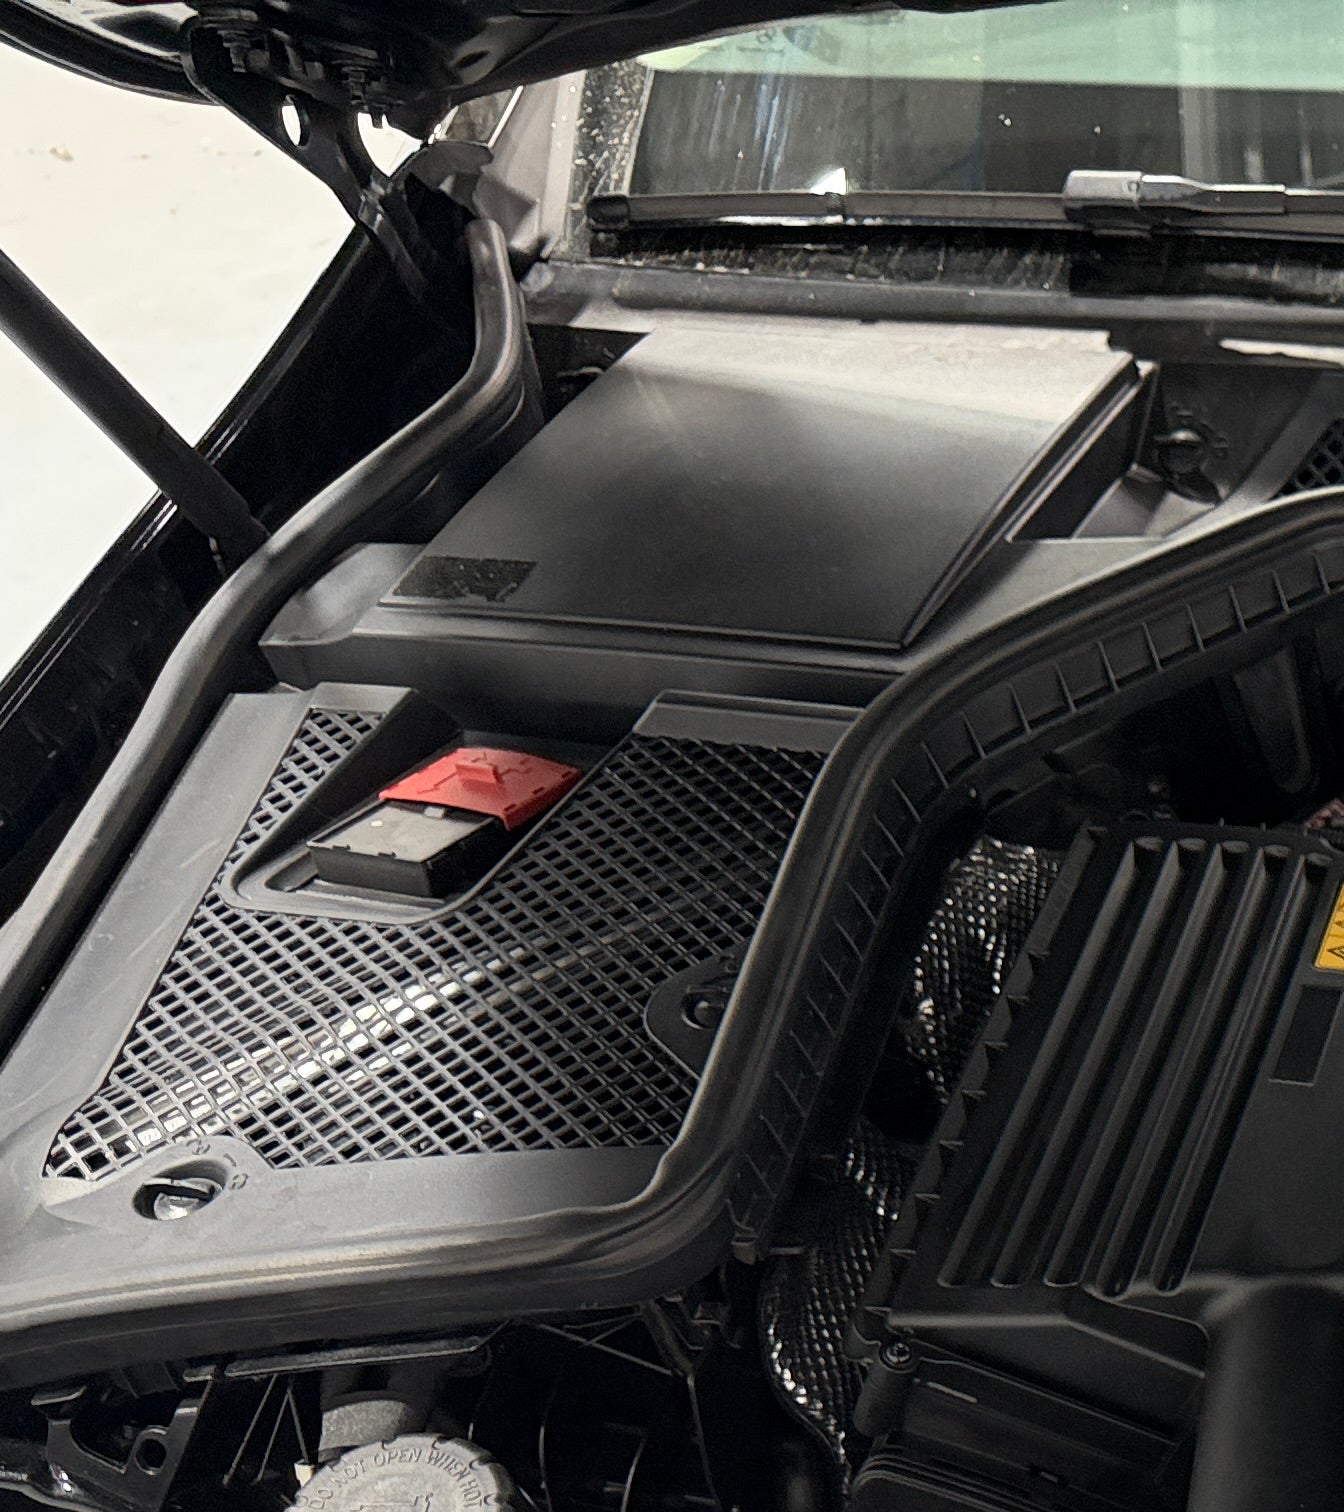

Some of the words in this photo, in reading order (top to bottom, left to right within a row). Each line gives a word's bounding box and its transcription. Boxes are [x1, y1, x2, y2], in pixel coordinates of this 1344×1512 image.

[308, 1488, 334, 1510] DO
[330, 1458, 367, 1488] NOT
[373, 1448, 423, 1468] OPEN
[459, 1478, 483, 1508] HOT
